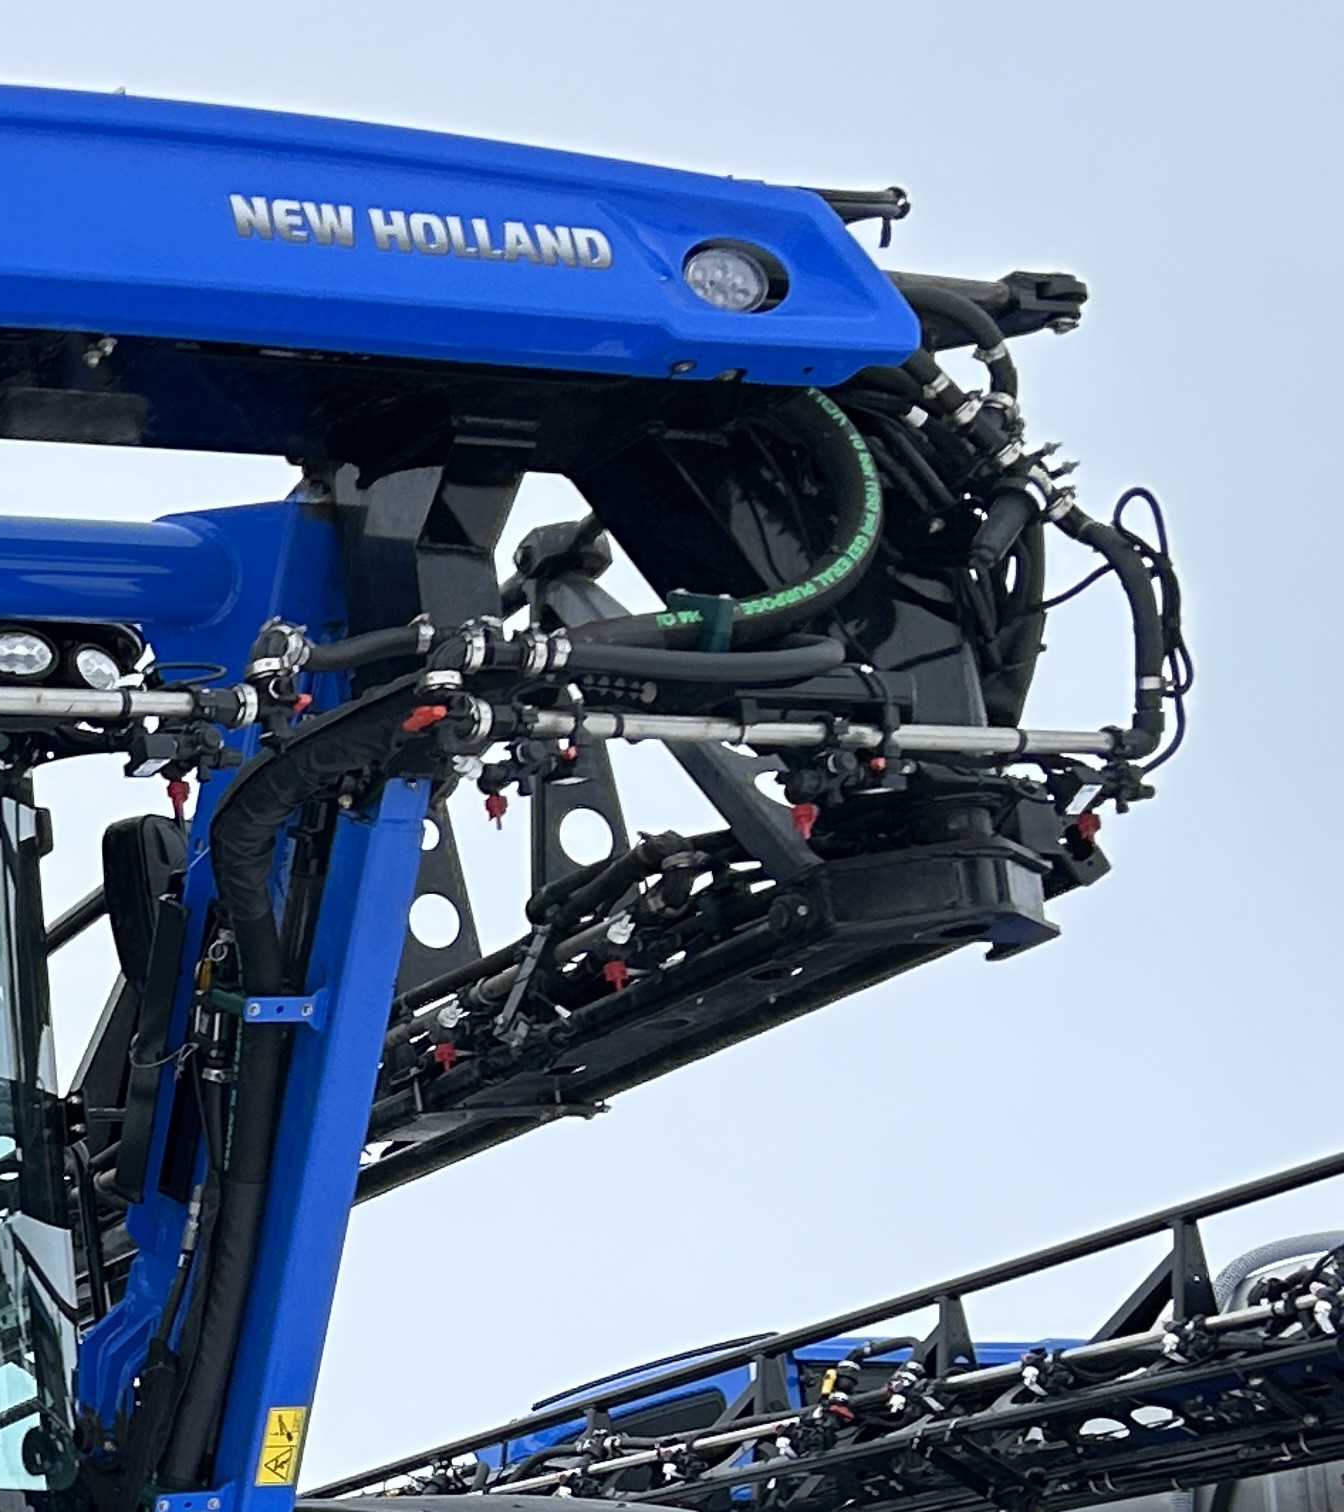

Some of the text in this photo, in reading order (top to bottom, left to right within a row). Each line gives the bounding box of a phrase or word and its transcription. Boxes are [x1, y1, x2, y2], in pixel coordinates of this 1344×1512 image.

[229, 193, 614, 269] NEW HOLLAND
[738, 581, 817, 616] PURPOSE
